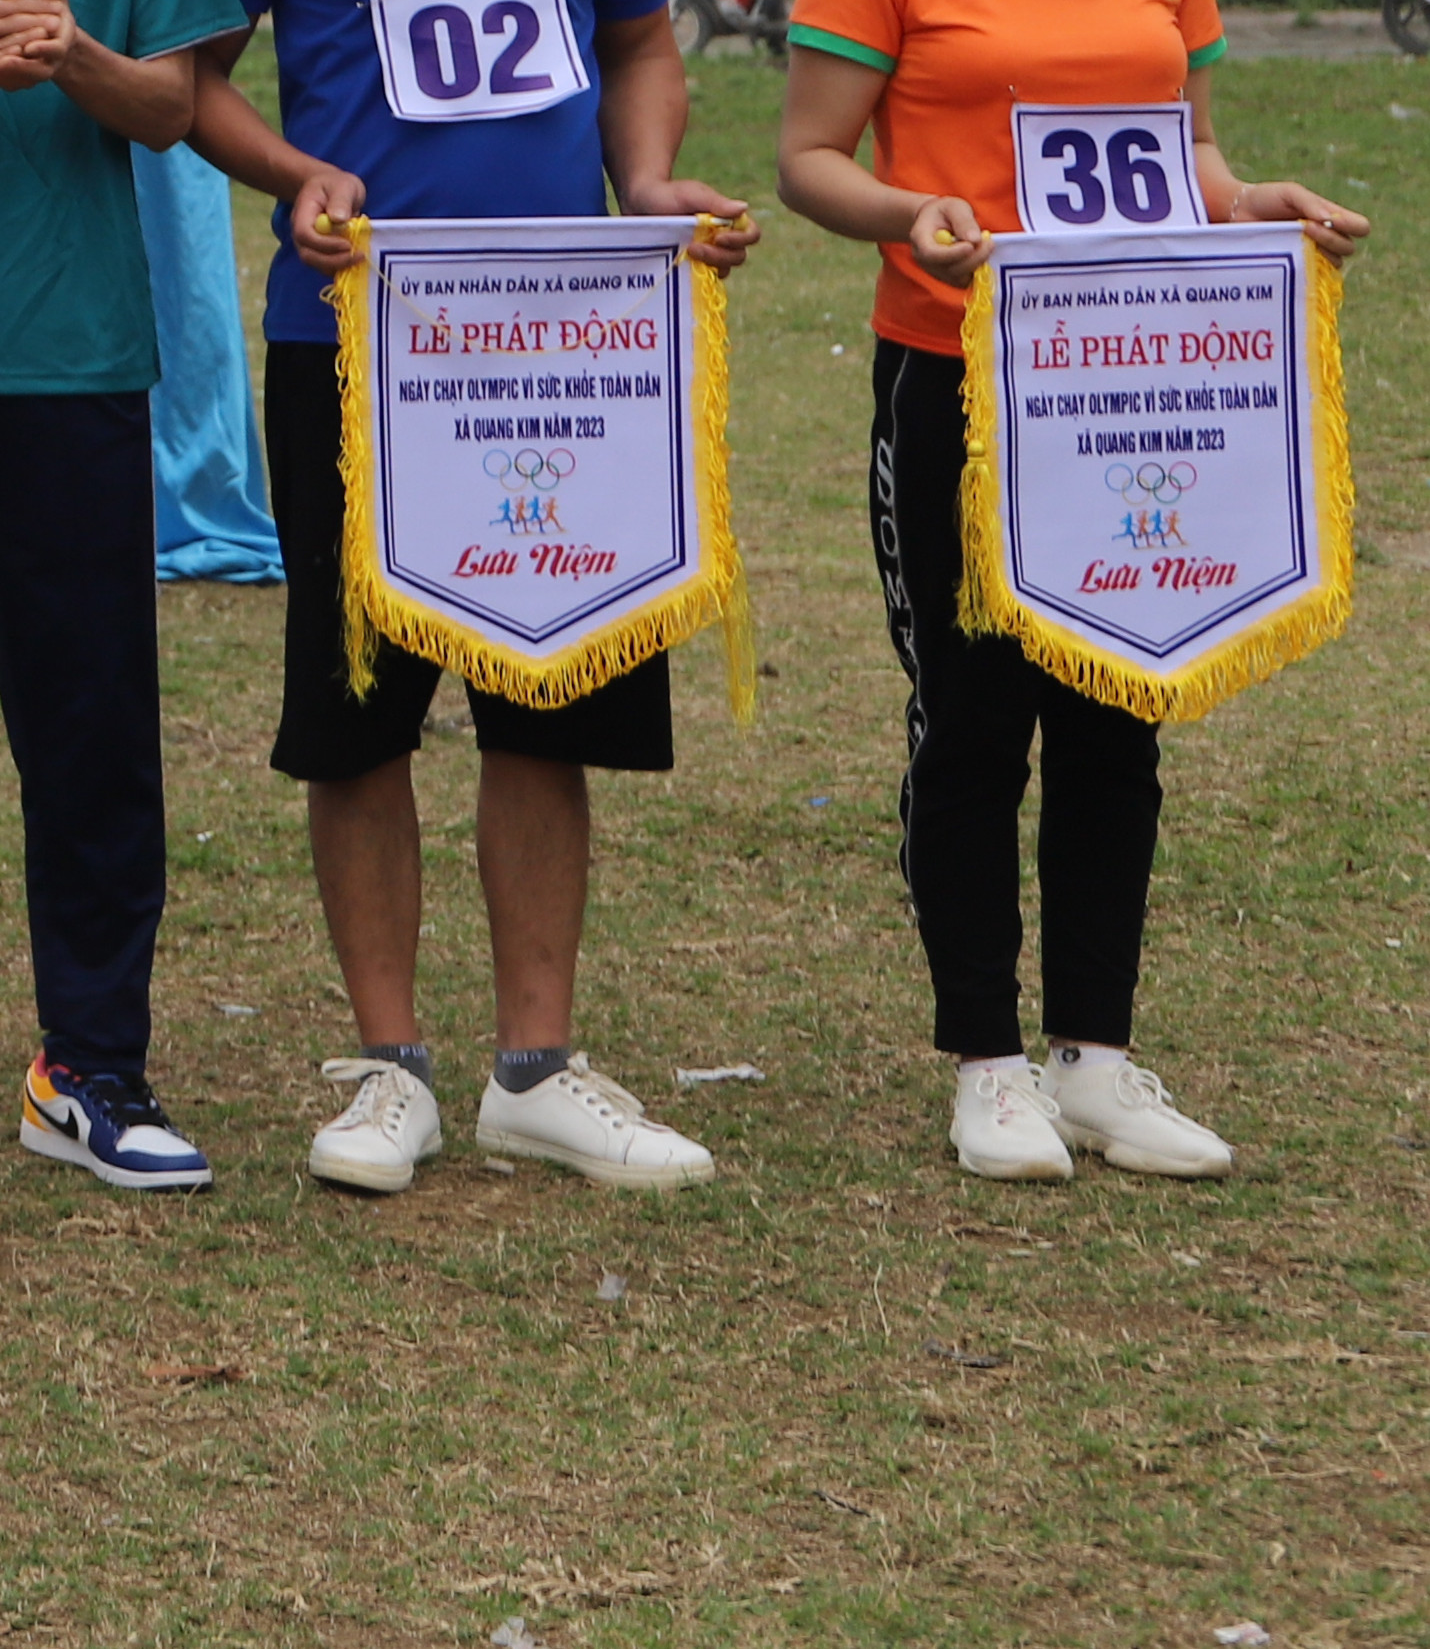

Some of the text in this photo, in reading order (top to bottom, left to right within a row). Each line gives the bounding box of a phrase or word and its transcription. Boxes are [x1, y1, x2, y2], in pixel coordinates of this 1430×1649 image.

[409, 0, 551, 99] 02
[1042, 128, 1171, 223] 36
[409, 307, 657, 358] LỄ PHÁT ĐỘNG
[1032, 320, 1274, 370] LỄ PHÁT ĐỘNG
